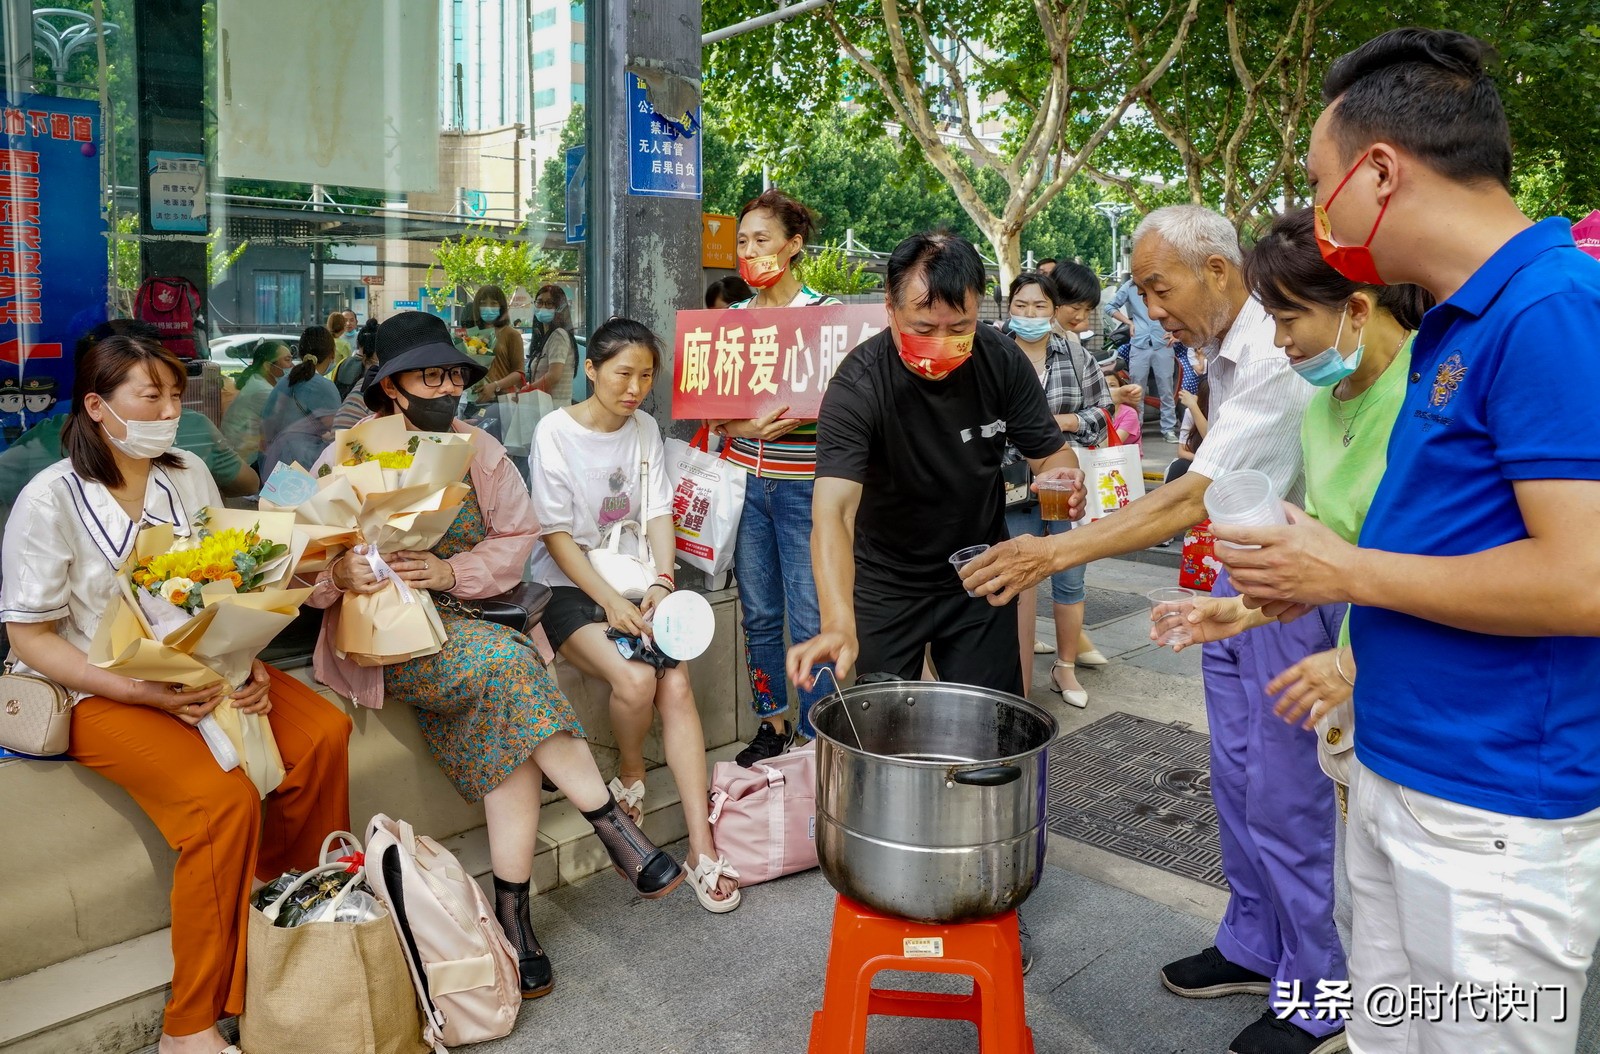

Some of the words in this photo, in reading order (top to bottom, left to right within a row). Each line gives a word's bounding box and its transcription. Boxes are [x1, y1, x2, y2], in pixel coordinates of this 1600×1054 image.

[0, 107, 93, 142] 地下通道
[639, 139, 684, 157] 无人看管
[651, 160, 695, 177] 后果自负
[162, 184, 196, 194] 雨雪天气
[0, 148, 43, 325] 高考便民服务点
[706, 242, 723, 250] CBD
